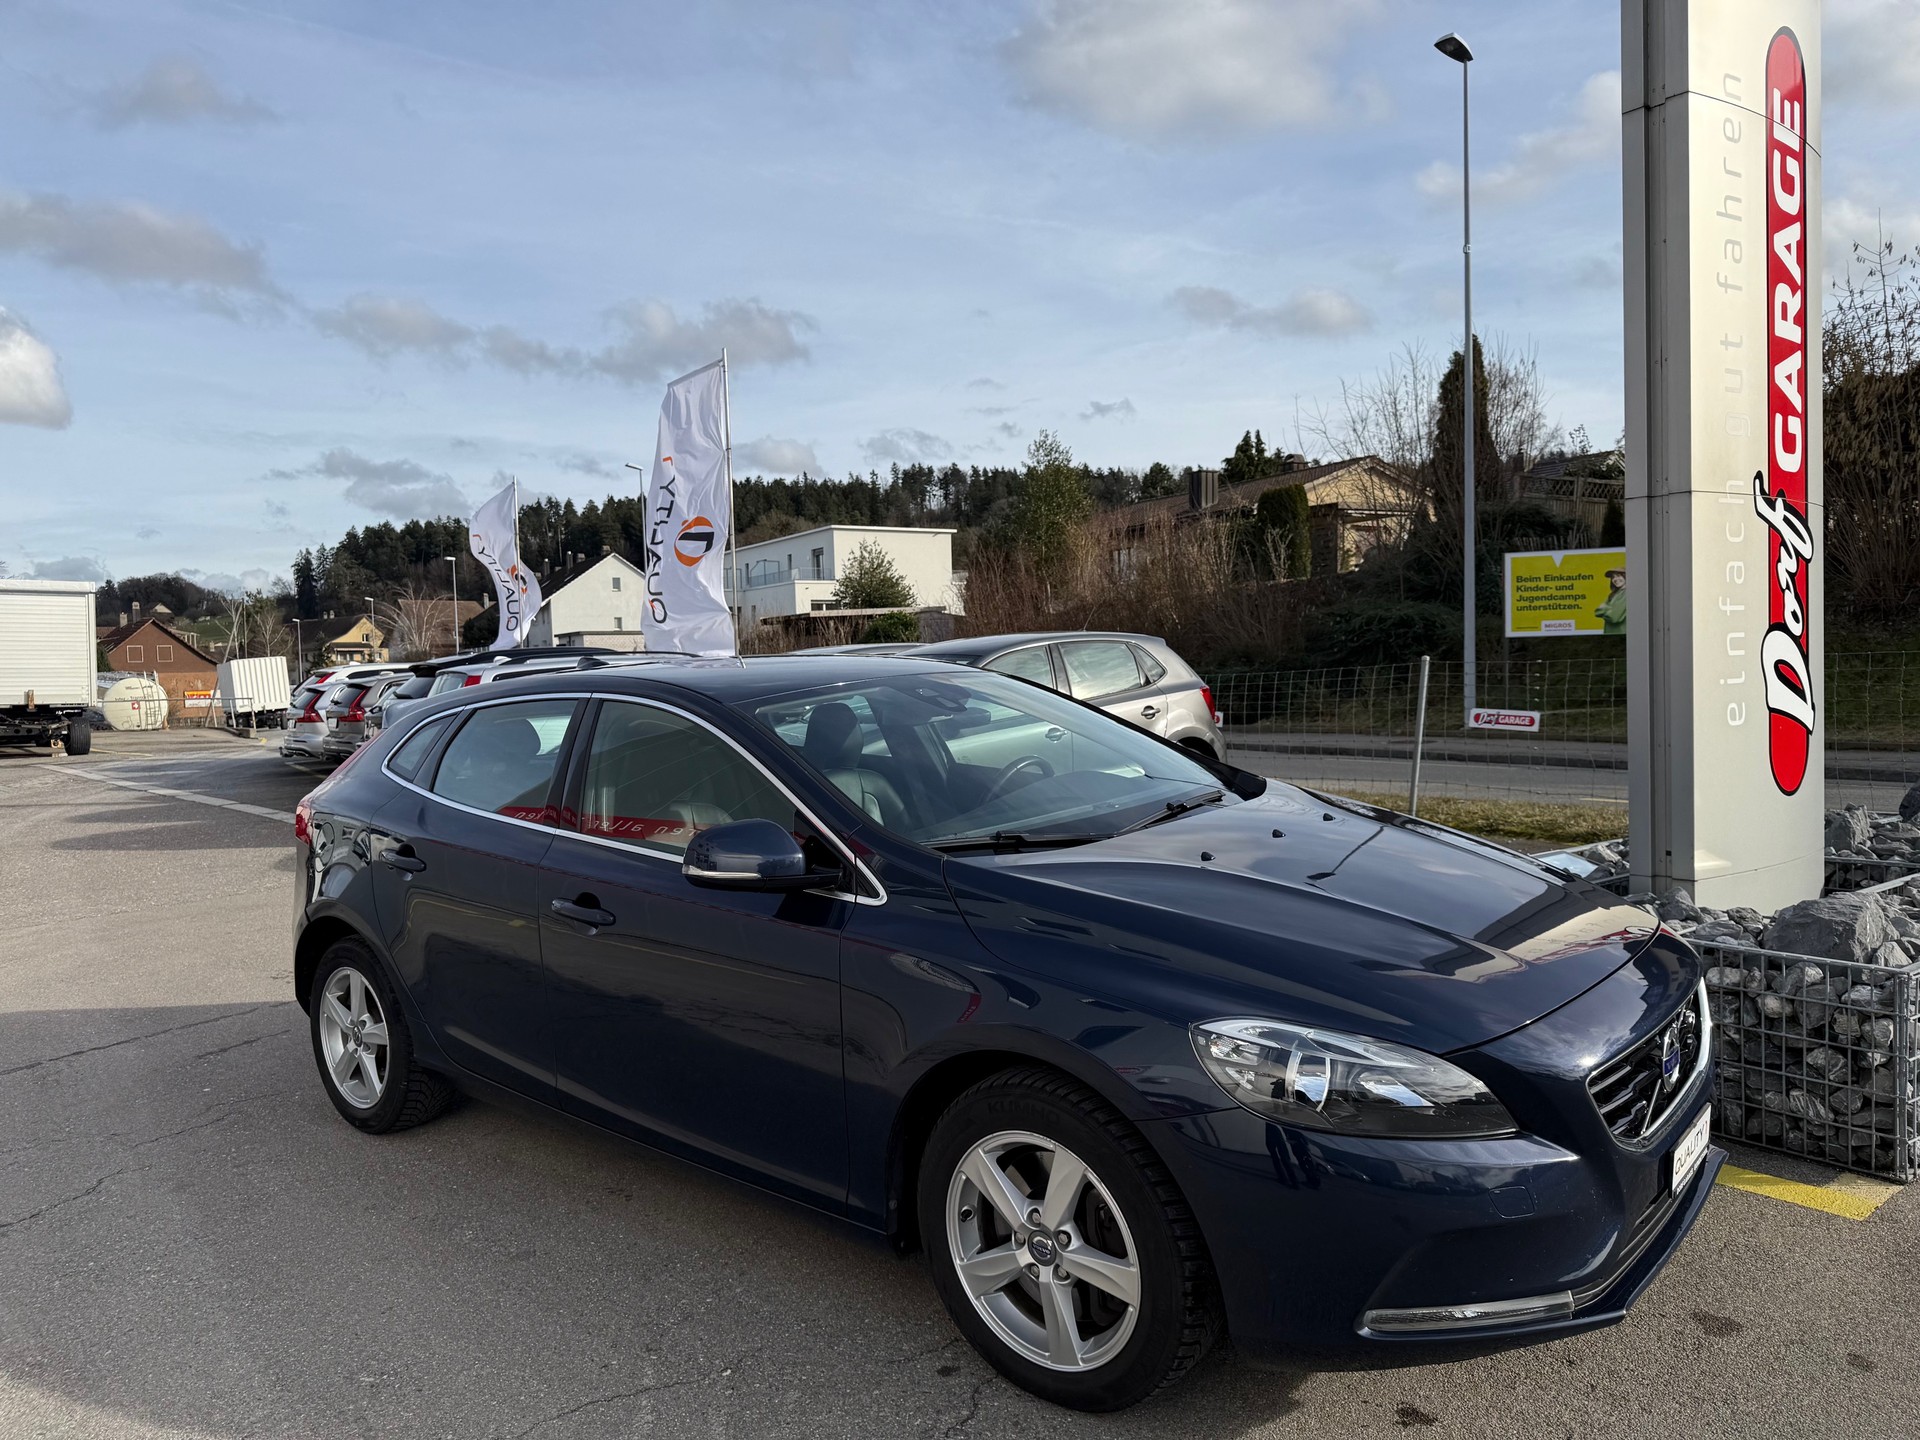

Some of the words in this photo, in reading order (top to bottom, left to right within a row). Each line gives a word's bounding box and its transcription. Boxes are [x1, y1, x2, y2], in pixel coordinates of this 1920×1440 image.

[1716, 71, 1744, 295] fahren
[1772, 87, 1803, 473] GARAGE
[1719, 333, 1751, 437] gut
[1516, 575, 1541, 583] Beim
[1544, 573, 1594, 582] Einkaufen
[1516, 585, 1553, 593] Kinder-
[1555, 583, 1574, 591] und
[1516, 593, 1587, 603] Jugendcamps
[1718, 479, 1746, 728] einfach
[1754, 471, 1814, 734] Dorf
[1516, 603, 1582, 612] unterstützen.
[1498, 715, 1531, 725] GARAGE
